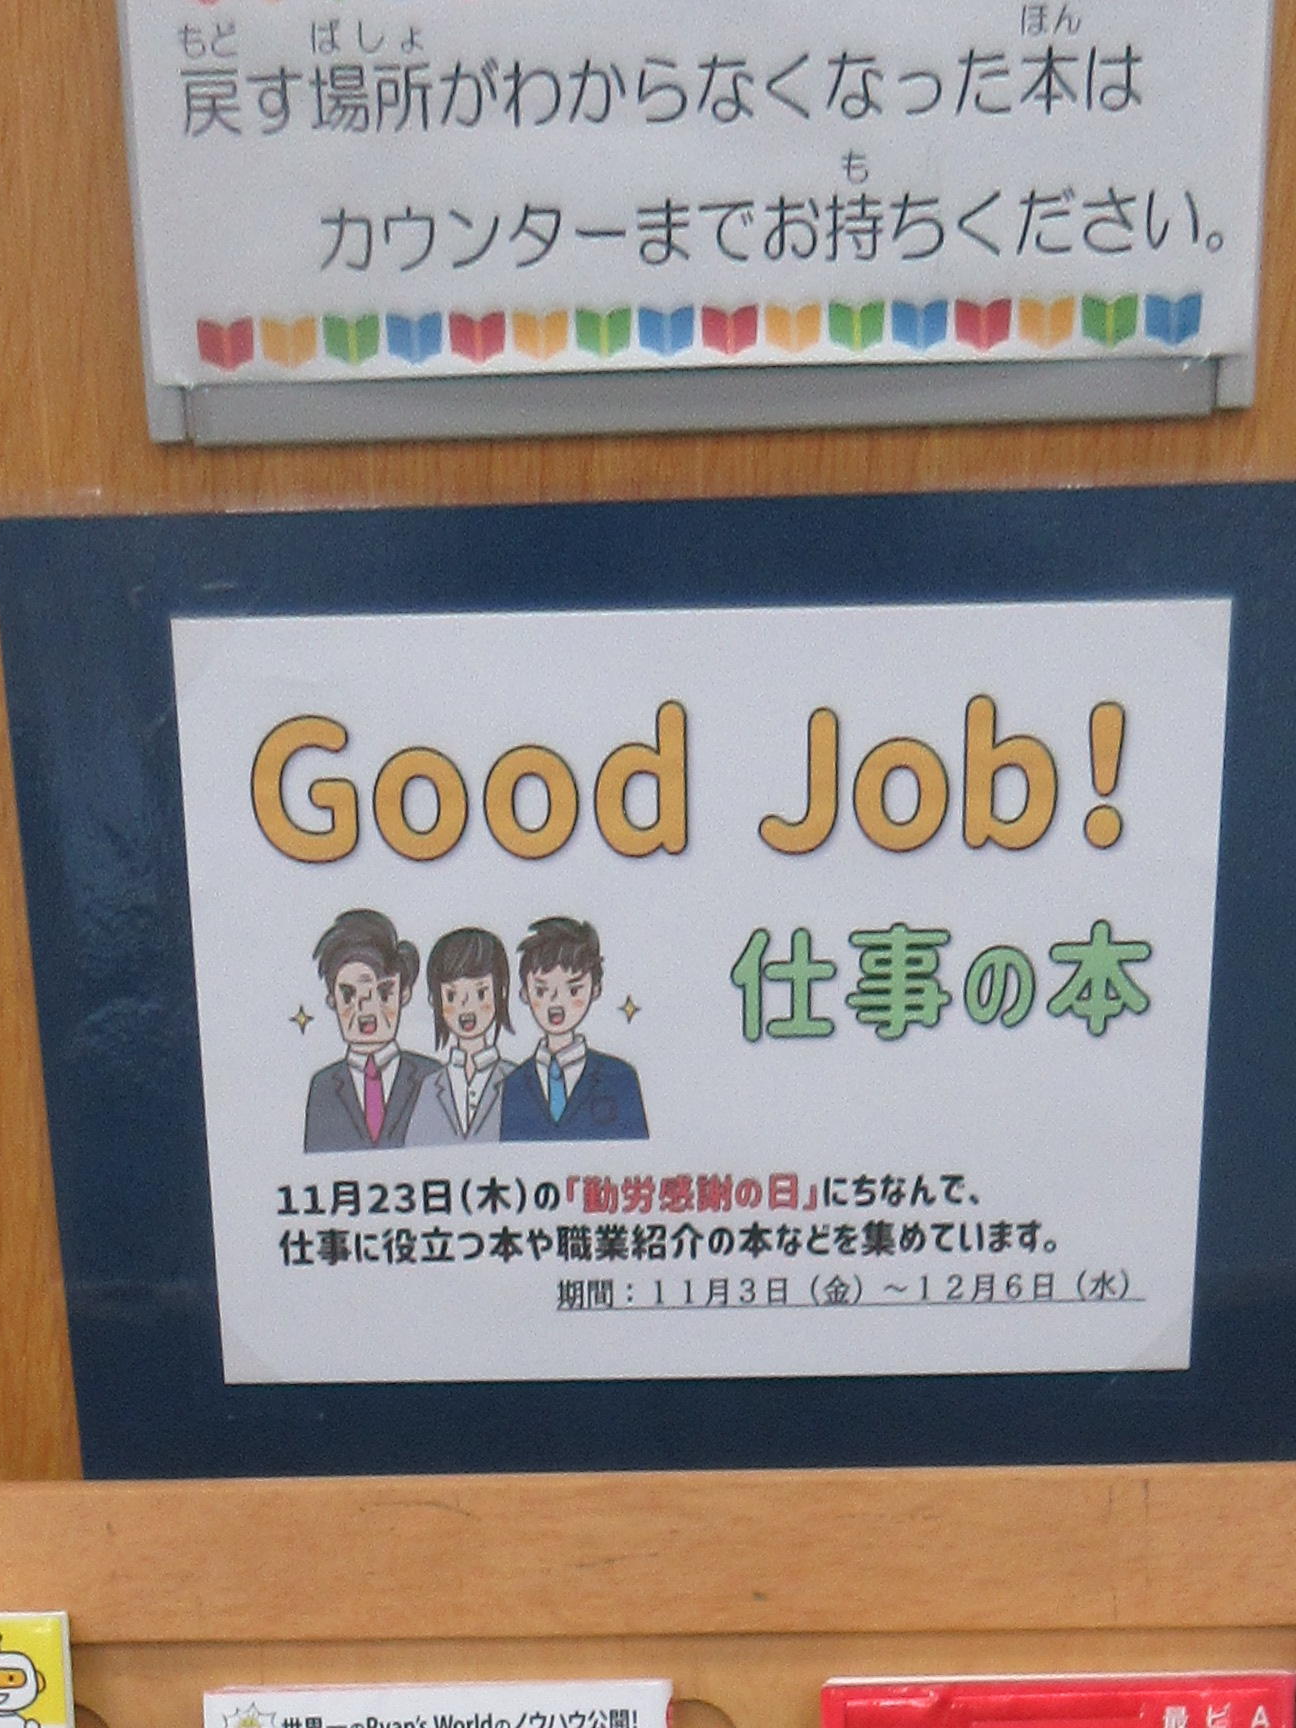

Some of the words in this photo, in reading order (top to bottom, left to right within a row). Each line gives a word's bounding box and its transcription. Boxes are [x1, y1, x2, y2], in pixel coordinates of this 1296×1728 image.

[178, 19, 238, 59] もど
[310, 18, 425, 55] ばしょ
[1019, 4, 1082, 37] ほん
[181, 42, 1144, 135] 戻す場所がわからなくなった本は
[841, 149, 871, 184] も
[319, 190, 1228, 271] カウンターまでお持ちください。
[250, 699, 689, 863] Good
[758, 694, 1126, 855] Job!
[730, 918, 1152, 1043] 仕事の本
[279, 1220, 1061, 1268] 仕事に役立つ本や職業紹介の本などを集めています。
